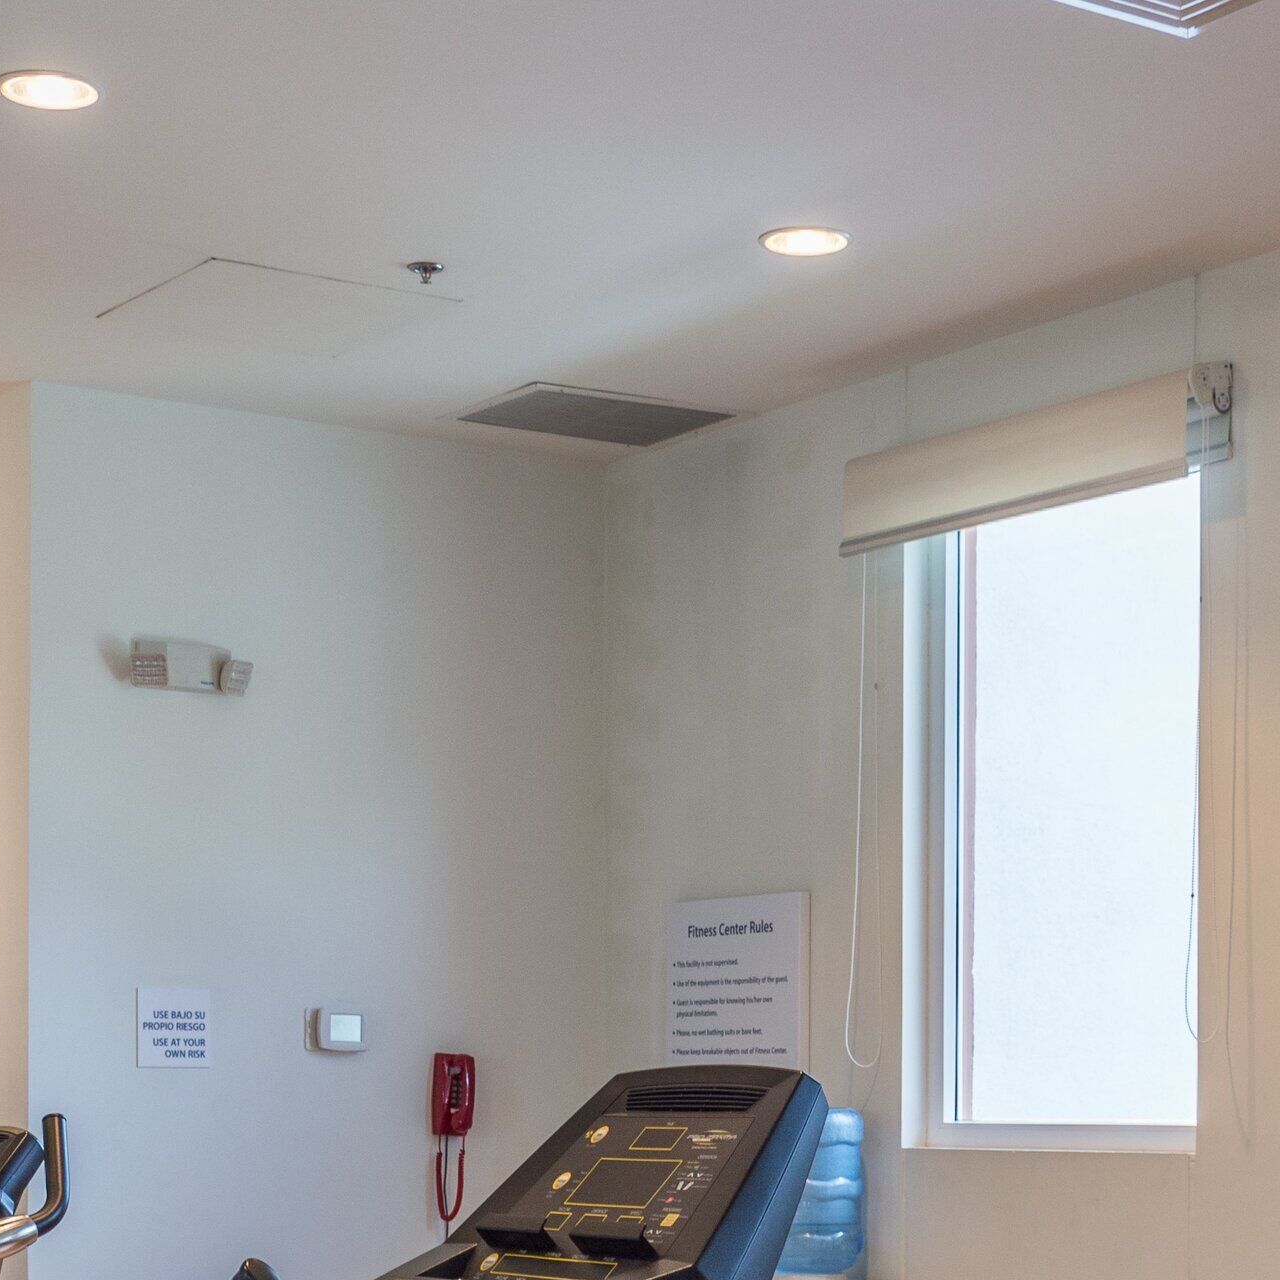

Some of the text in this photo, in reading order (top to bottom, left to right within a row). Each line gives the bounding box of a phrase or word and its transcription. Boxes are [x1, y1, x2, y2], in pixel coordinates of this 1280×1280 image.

[687, 920, 774, 938] Fitness Center Rules
[153, 1010, 206, 1020] USE BAJO SU
[142, 1022, 206, 1031] PROPIO RIESGO
[706, 1028, 724, 1037] bathing
[152, 1038, 206, 1047] USE AT YOUR
[165, 1049, 206, 1058] OWN RISK
